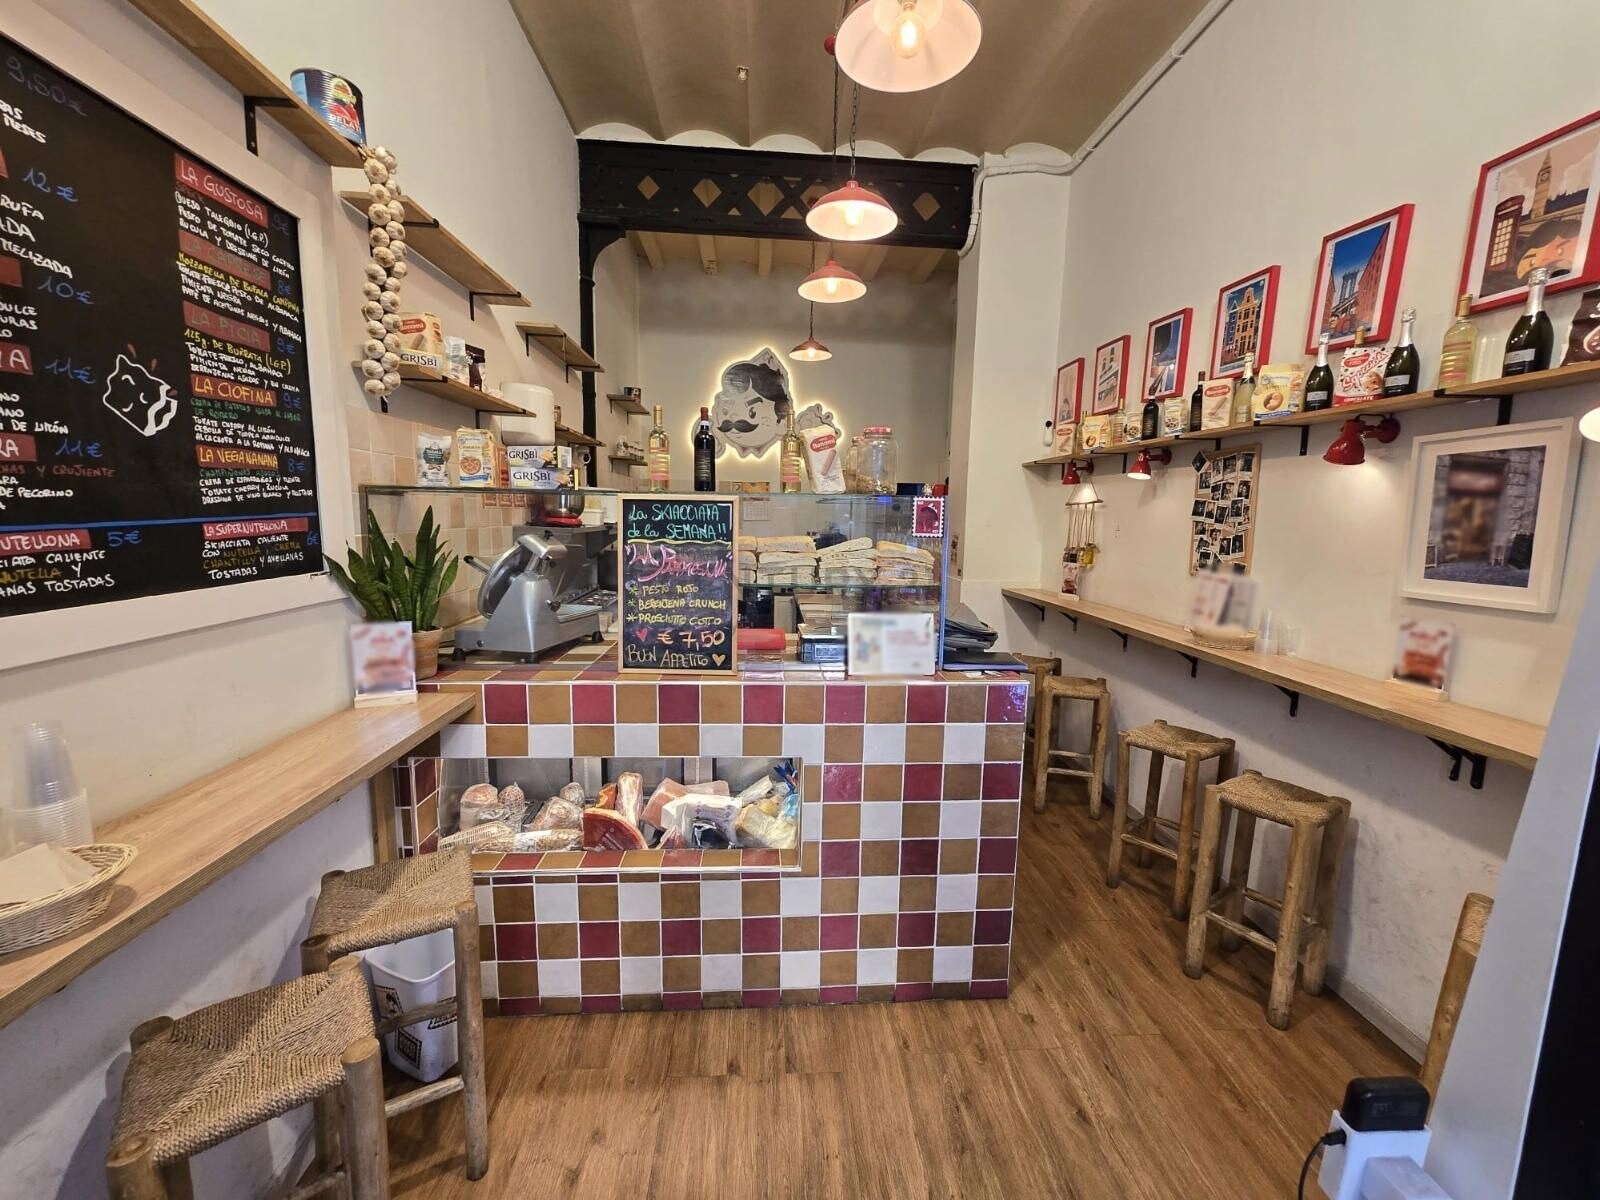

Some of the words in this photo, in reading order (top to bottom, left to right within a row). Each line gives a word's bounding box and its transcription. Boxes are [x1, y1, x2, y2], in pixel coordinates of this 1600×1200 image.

[23, 167, 52, 193] 12
[181, 160, 200, 187] LA
[203, 175, 264, 221] GUSTOSA
[178, 205, 202, 225] PESTO
[214, 235, 223, 248] Y
[37, 276, 74, 298] 10
[212, 338, 224, 350] DE
[0, 348, 30, 372] A
[195, 377, 214, 395] LA
[217, 382, 274, 406] CIOFINA
[11, 419, 28, 432] DE
[200, 447, 215, 464] LA
[17, 487, 74, 498] PECORINO
[200, 487, 232, 498] TOMATE
[628, 504, 647, 521] La
[650, 503, 719, 522] SKIACCIATA
[204, 525, 214, 537] LA
[627, 523, 642, 538] de
[643, 524, 660, 538] la
[203, 538, 252, 552] SKIACCIATA
[45, 550, 106, 565] CALIENTE
[201, 548, 221, 559] CON
[258, 555, 266, 568] Y
[71, 563, 83, 578] Y
[207, 565, 259, 581] TOSTADAS
[43, 573, 116, 593] TOSTADAS
[642, 584, 670, 595] PESTO
[676, 583, 700, 595] ROJO
[638, 598, 686, 611] BERENJENA
[688, 598, 727, 611] CRUNCH
[689, 616, 722, 626] COTTO
[657, 630, 674, 645] €
[679, 630, 726, 651] 7,50
[627, 644, 657, 663] BUON
[660, 650, 709, 669] APPETITO
